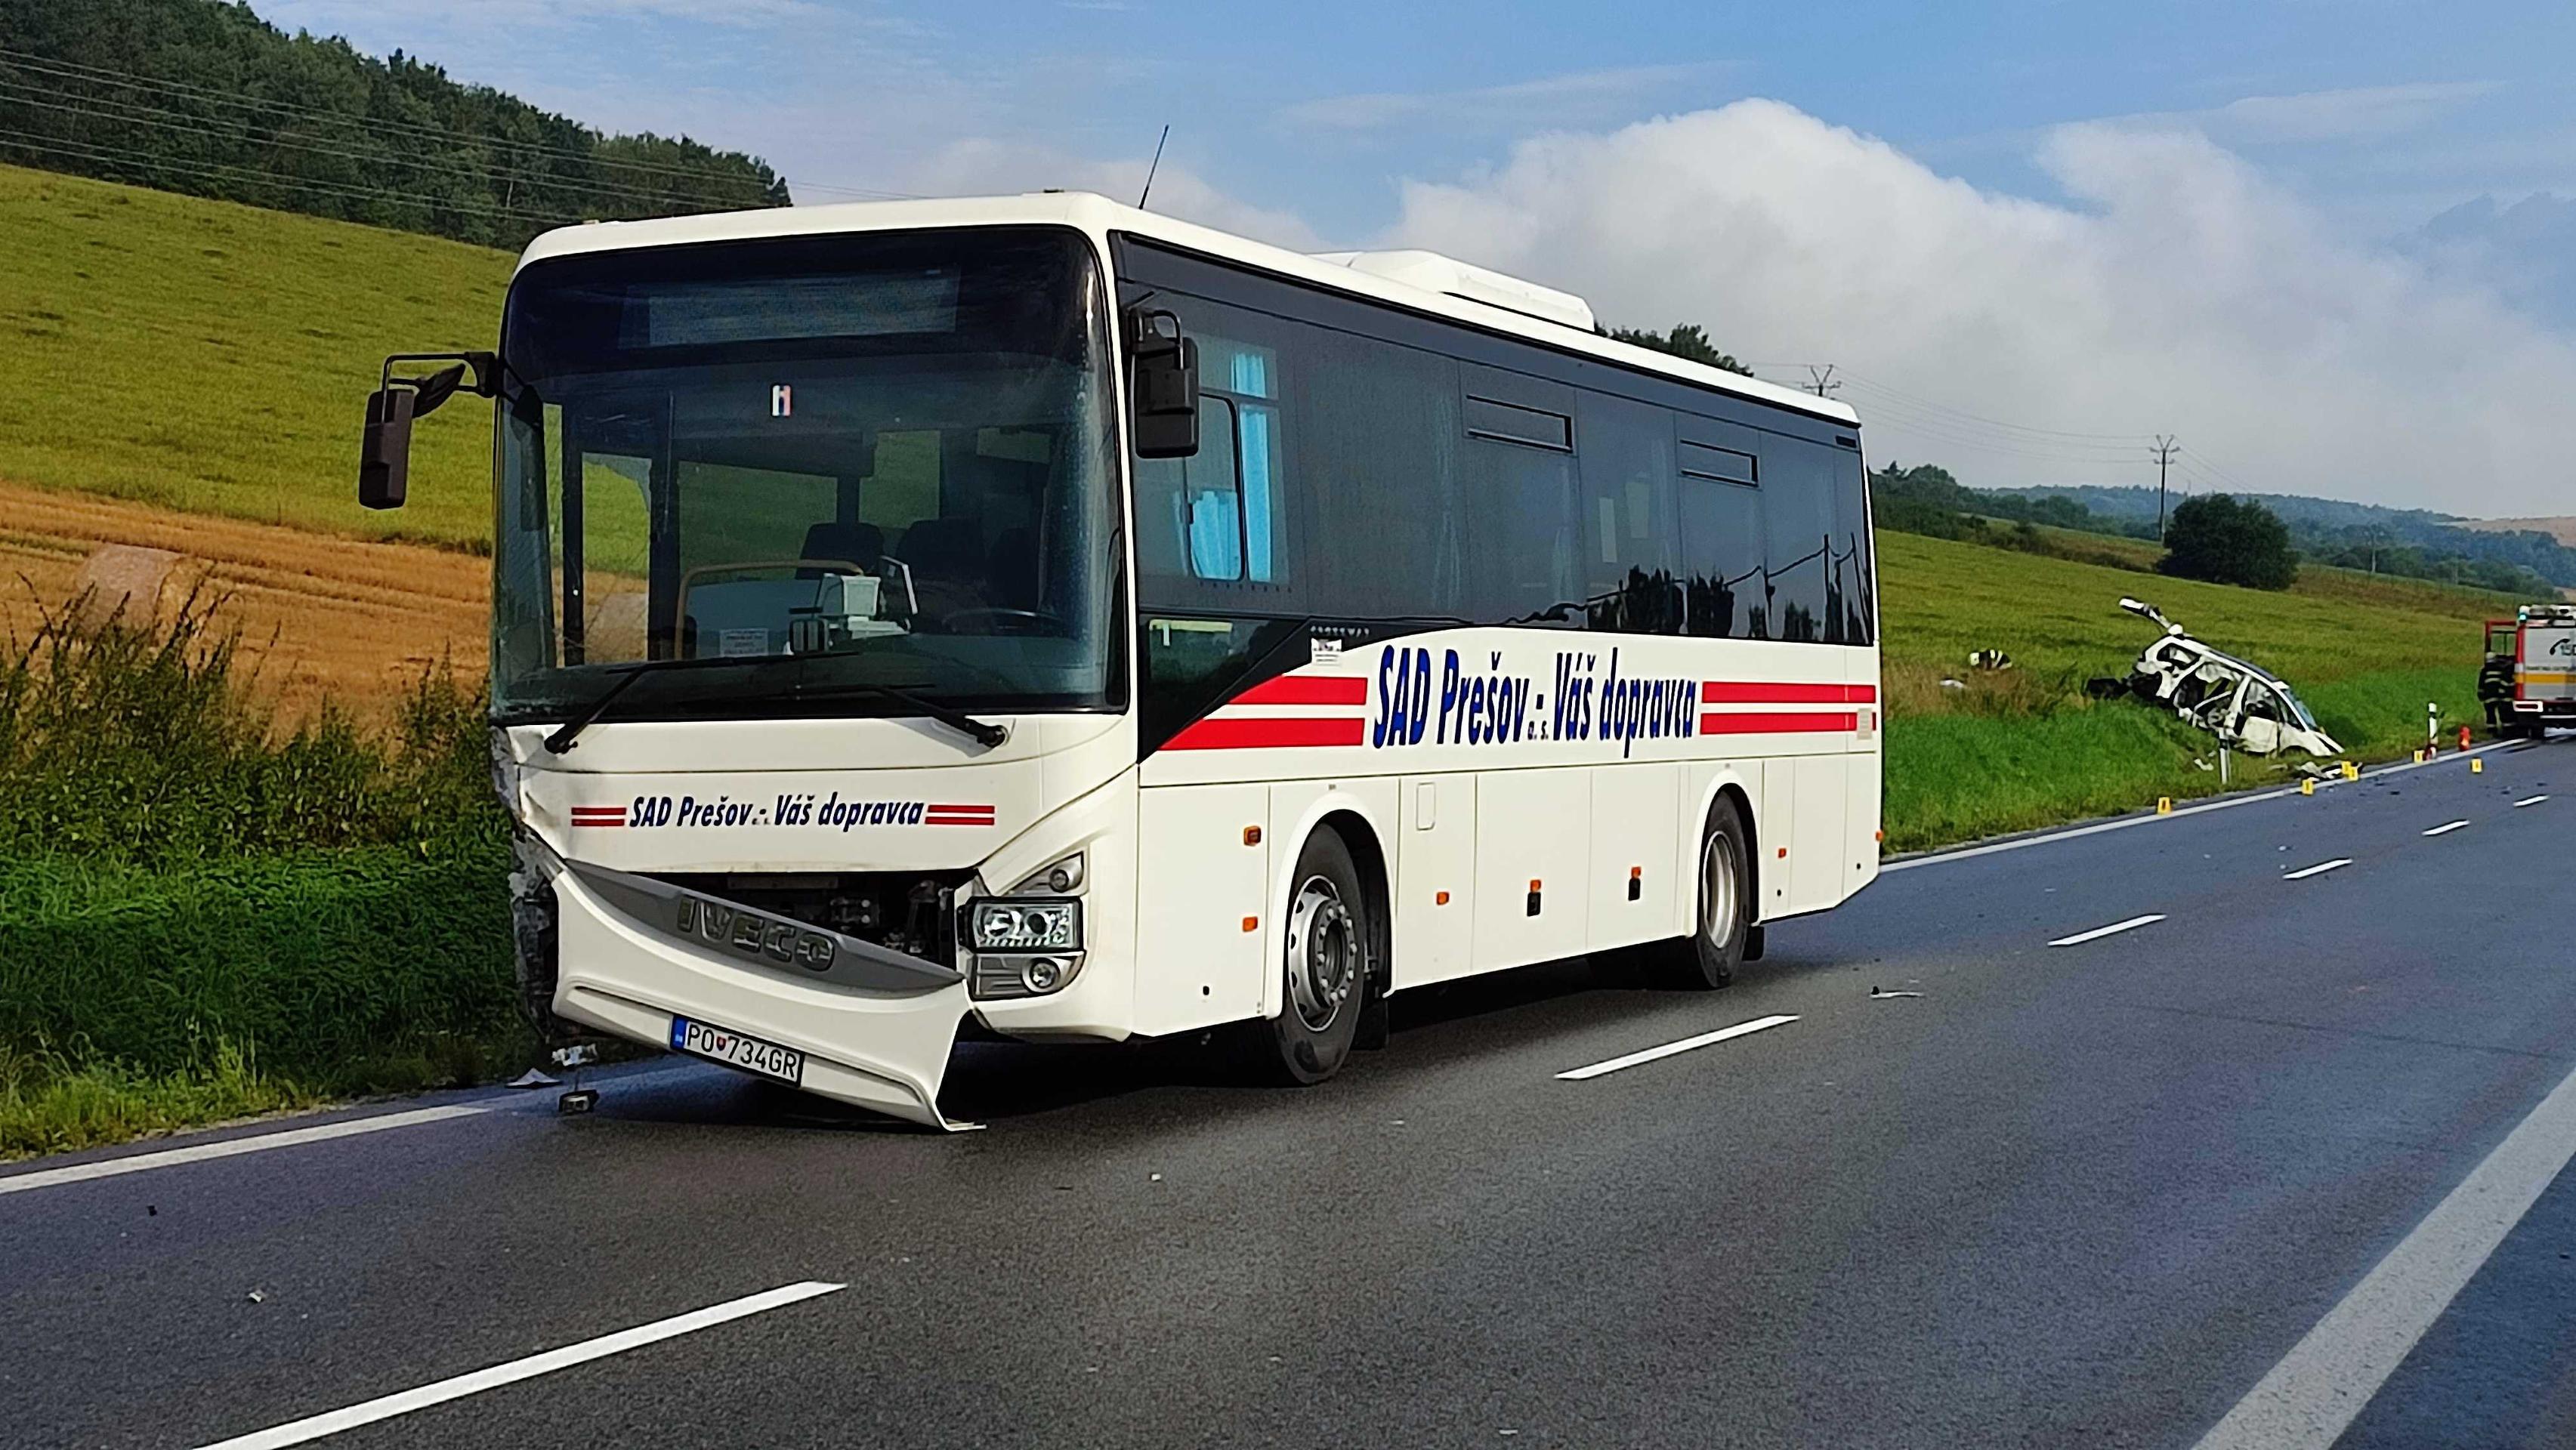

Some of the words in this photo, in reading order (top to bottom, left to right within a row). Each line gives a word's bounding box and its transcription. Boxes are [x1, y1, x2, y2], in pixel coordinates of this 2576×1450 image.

[1373, 644, 1431, 749] SAD
[1436, 649, 1530, 745] Prešov
[1553, 652, 1596, 741] Váš
[1599, 646, 1697, 759] dopravca
[629, 796, 672, 828] SAD
[676, 795, 754, 827] Prešov
[774, 794, 815, 825] Váš
[818, 791, 925, 832] dopravca
[677, 893, 836, 973] IVECO
